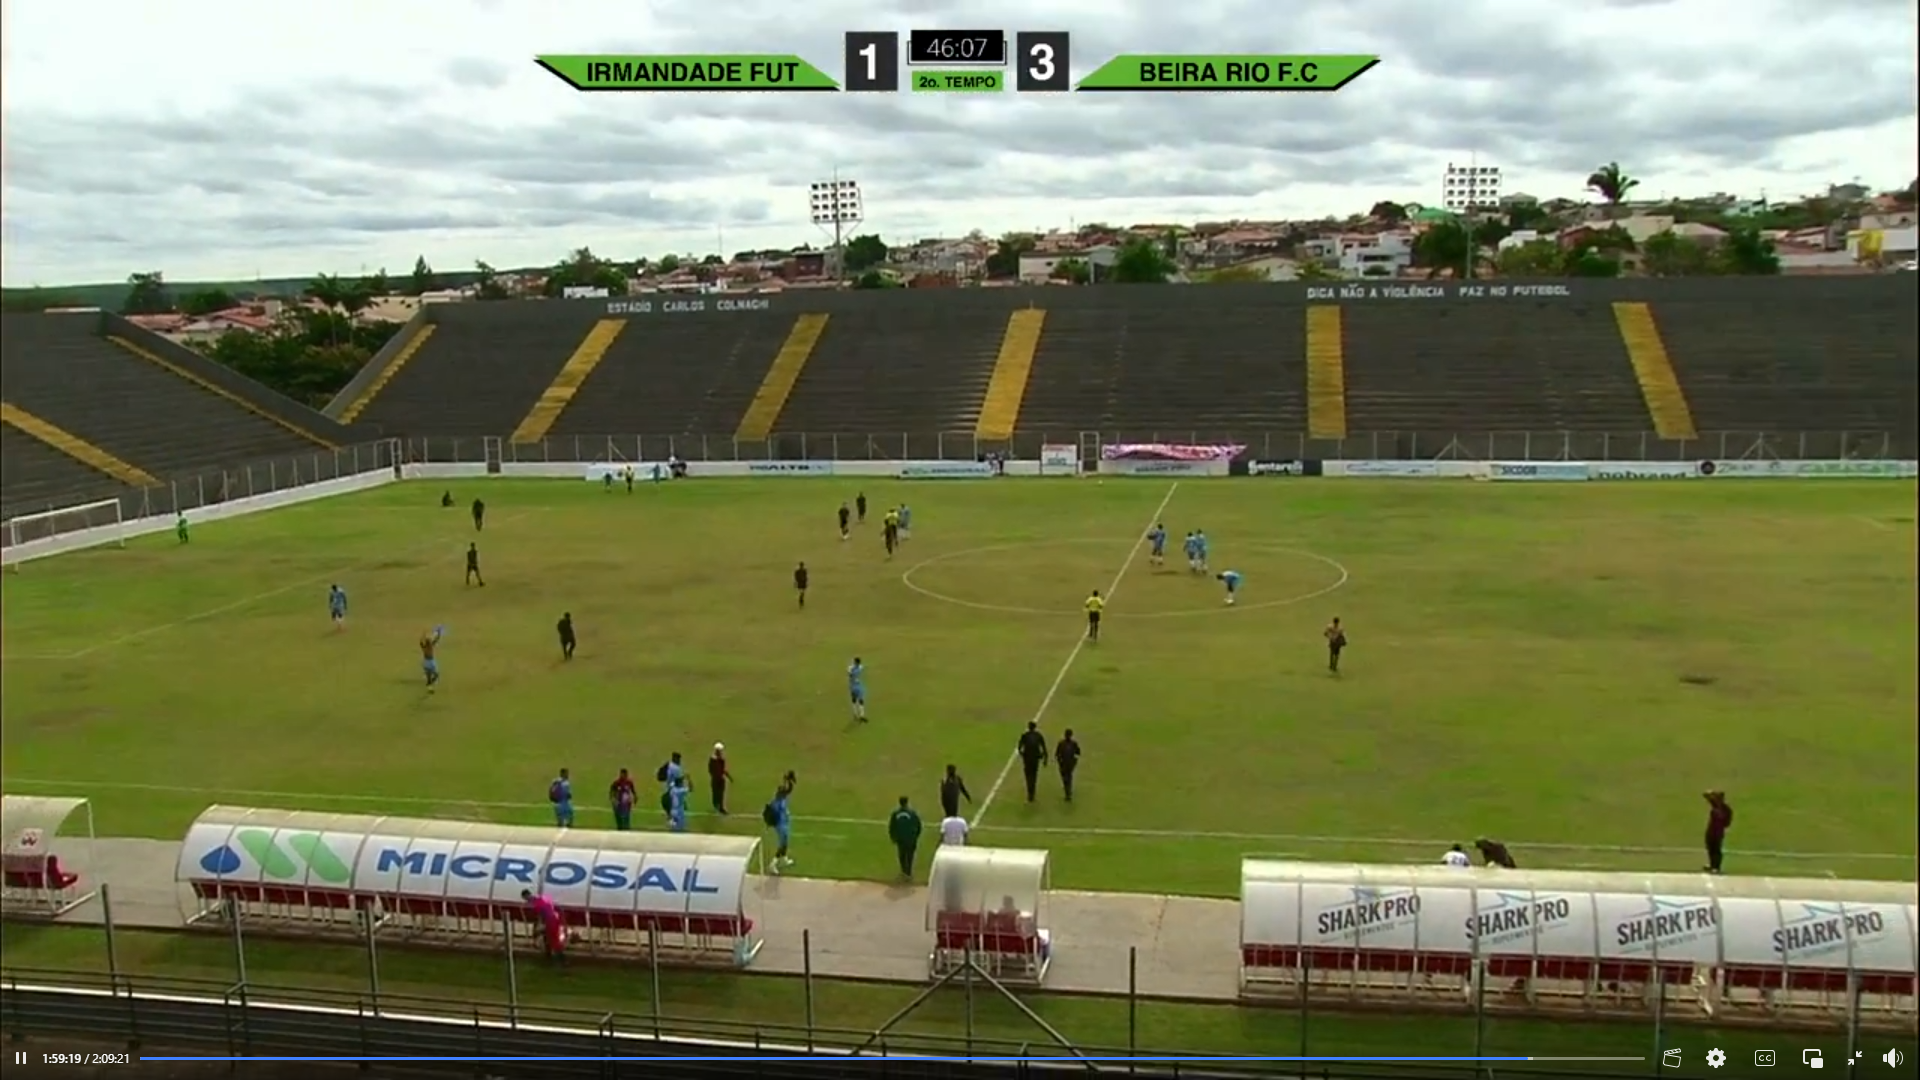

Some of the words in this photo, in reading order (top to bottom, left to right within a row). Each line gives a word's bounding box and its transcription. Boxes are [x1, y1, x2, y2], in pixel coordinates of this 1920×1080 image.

[663, 300, 706, 313] CARLOS
[1368, 286, 1379, 298] A
[1459, 286, 1486, 298] PAZ
[1490, 285, 1508, 297] NO
[1513, 284, 1571, 297] FUTEBOL
[376, 848, 720, 894] MICROSAL
[1317, 904, 1381, 935] SHARK
[1384, 893, 1421, 920] PRO
[1465, 904, 1530, 940] SHARK
[1616, 911, 1683, 946] SHARK
[1773, 918, 1842, 953] SHARK
